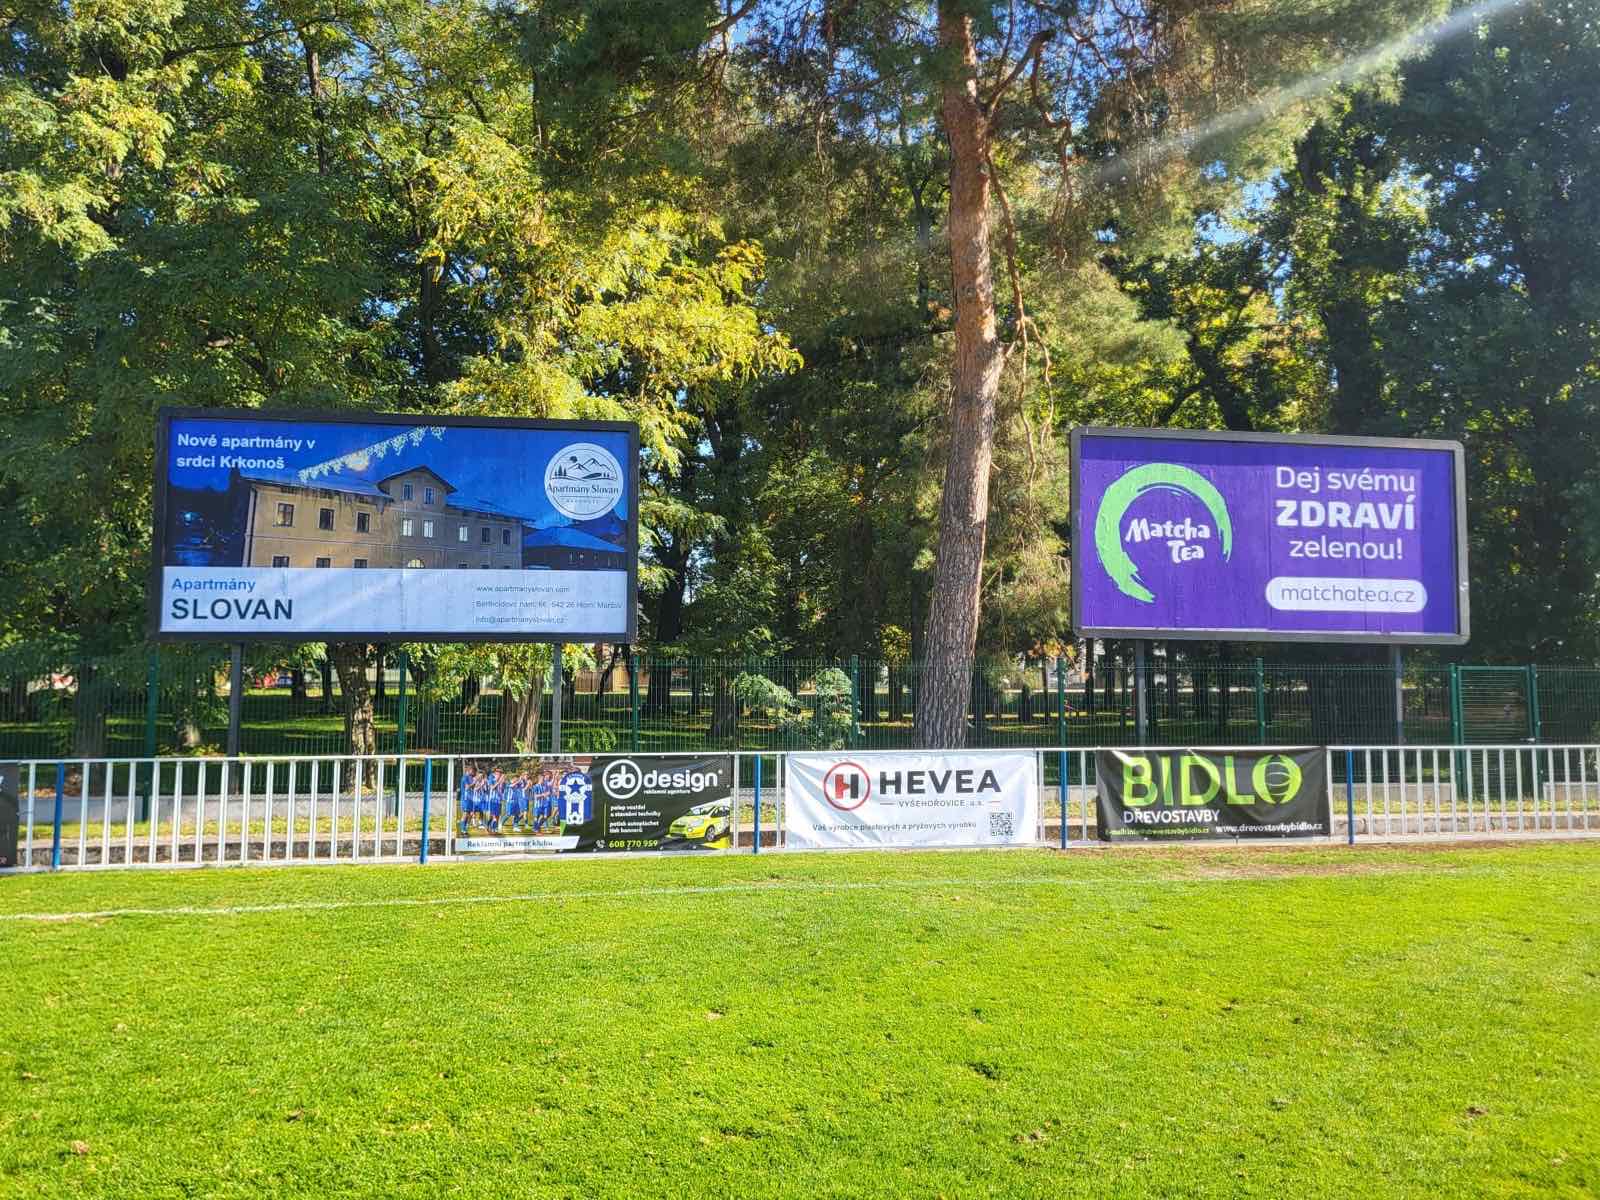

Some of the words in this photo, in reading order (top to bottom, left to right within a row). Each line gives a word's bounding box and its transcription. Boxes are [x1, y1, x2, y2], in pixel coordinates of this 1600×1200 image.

[177, 433, 217, 447] Nové
[222, 435, 302, 452] apartmány
[306, 438, 316, 449] v
[176, 456, 216, 468] srdci
[220, 456, 285, 469] Krkonoš
[591, 484, 619, 494] Slovan
[1275, 466, 1320, 494] Dej
[1327, 467, 1416, 492] svému
[1275, 494, 1416, 530] ZDRAVÍ
[1125, 517, 1211, 543] Matcha
[1288, 534, 1403, 560] zelenou!
[171, 578, 256, 593] Apartmány
[1281, 586, 1417, 603] matchatea.cz
[171, 598, 293, 620] SLOVAN
[608, 765, 636, 789] ab
[643, 769, 718, 793] design
[879, 769, 1002, 795] HEVEA
[1122, 754, 1303, 806] BIDLO
[898, 799, 966, 809] VYŠEHOŘOVICE
[1123, 808, 1221, 824] DŘEVOSTAVBY
[812, 823, 827, 832] Váš
[1215, 821, 1323, 834] www.drevostavbybidlo.cz
[608, 840, 625, 848] 608
[626, 839, 642, 848] 770
[643, 839, 658, 848] 959
